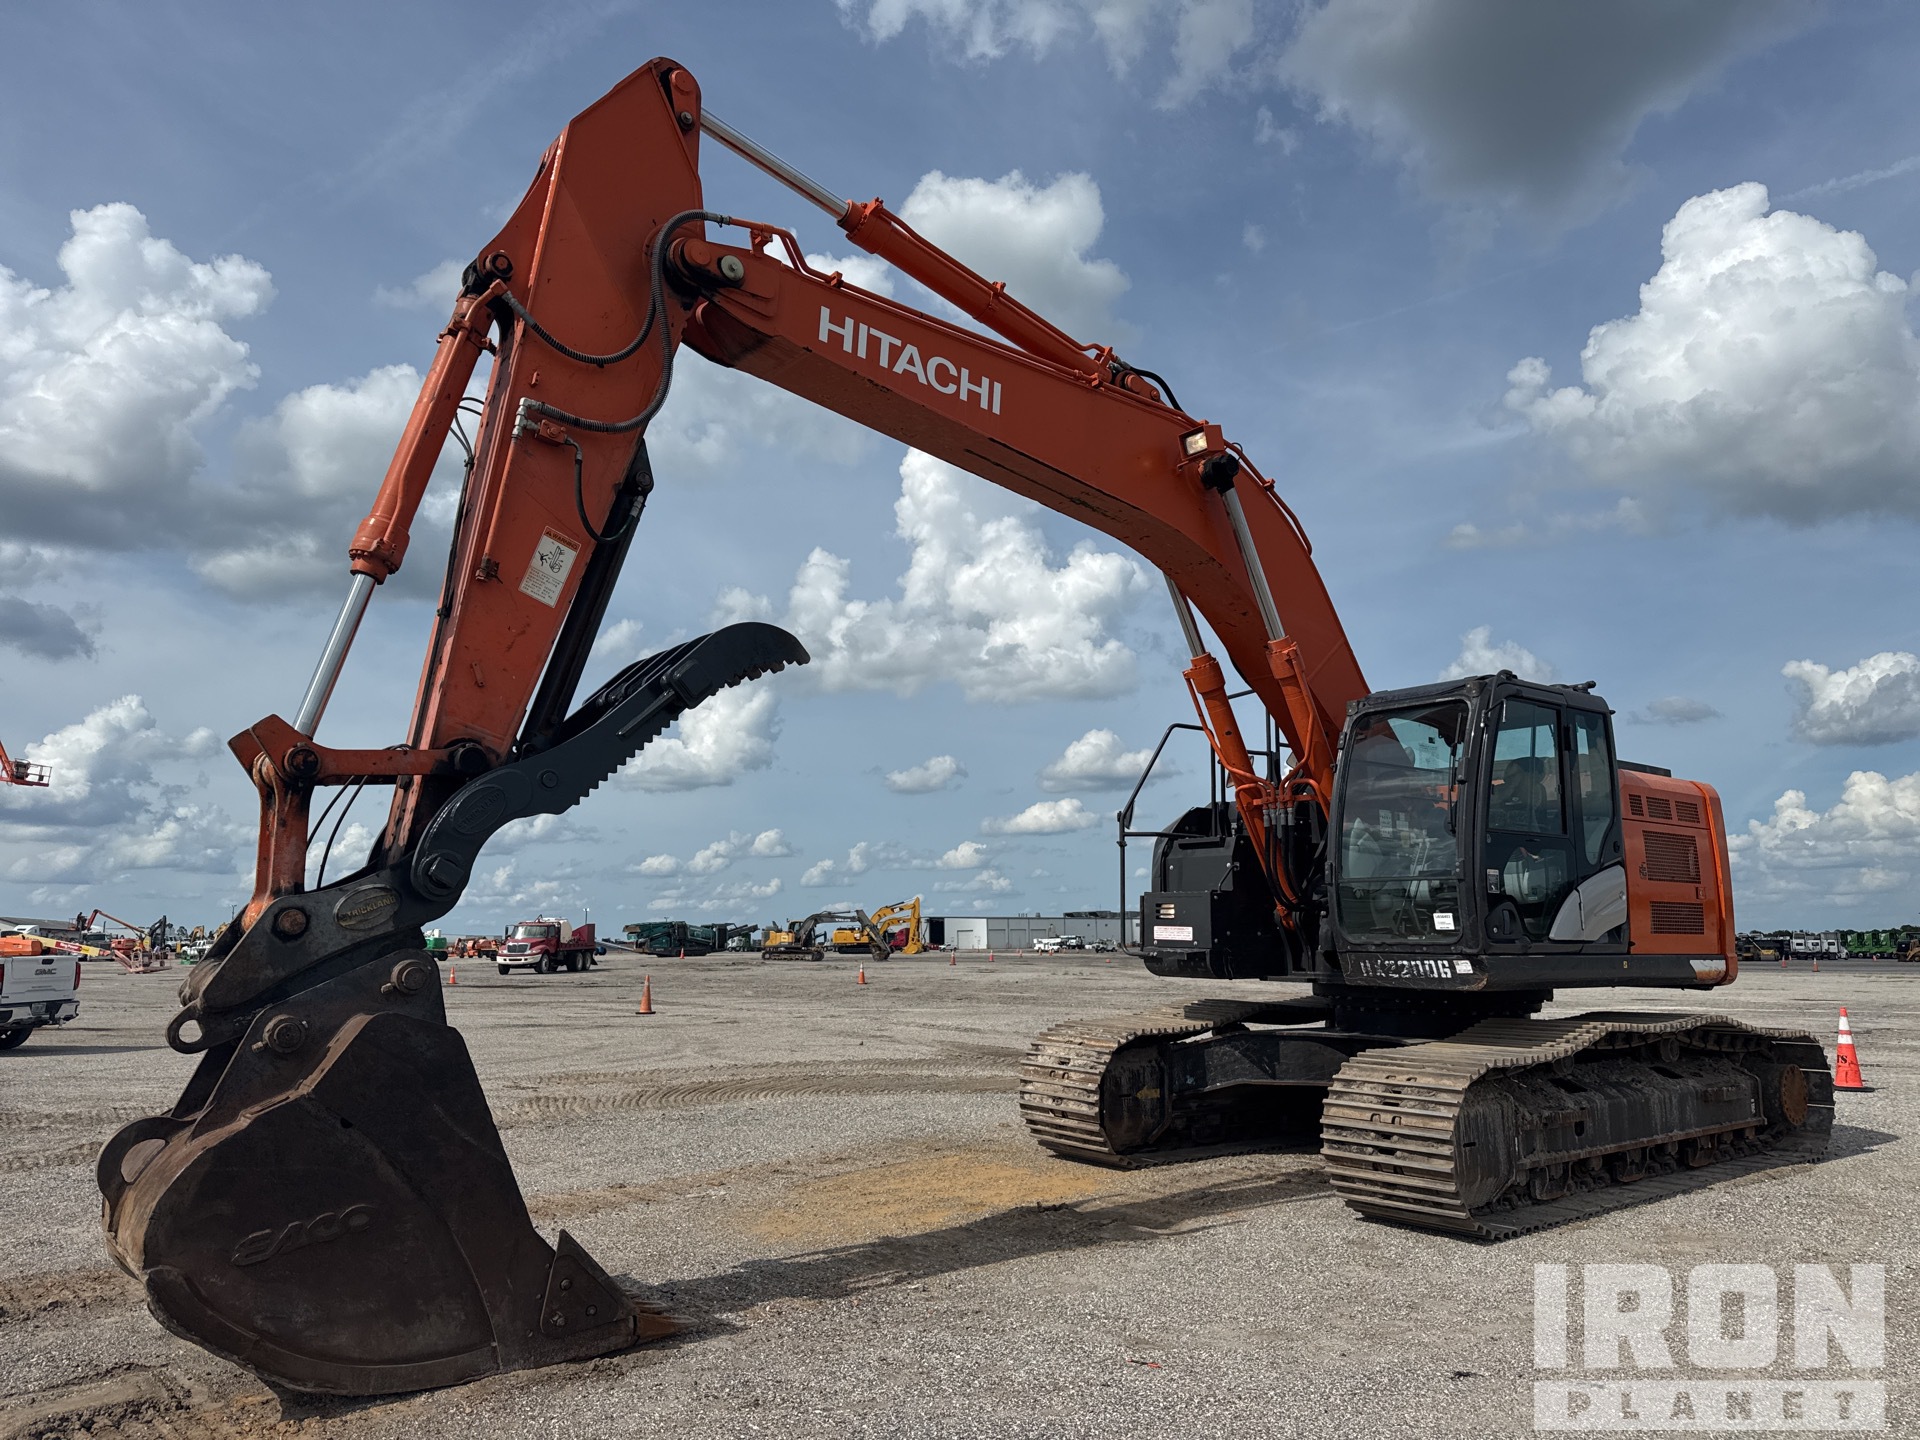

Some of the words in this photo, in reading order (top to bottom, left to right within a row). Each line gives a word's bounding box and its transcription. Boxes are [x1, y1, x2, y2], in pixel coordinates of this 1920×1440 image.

[818, 305, 1002, 415] HITACHI
[552, 533, 578, 550] WARNING
[337, 895, 397, 921] STRICKLAND
[34, 968, 57, 976] GMC
